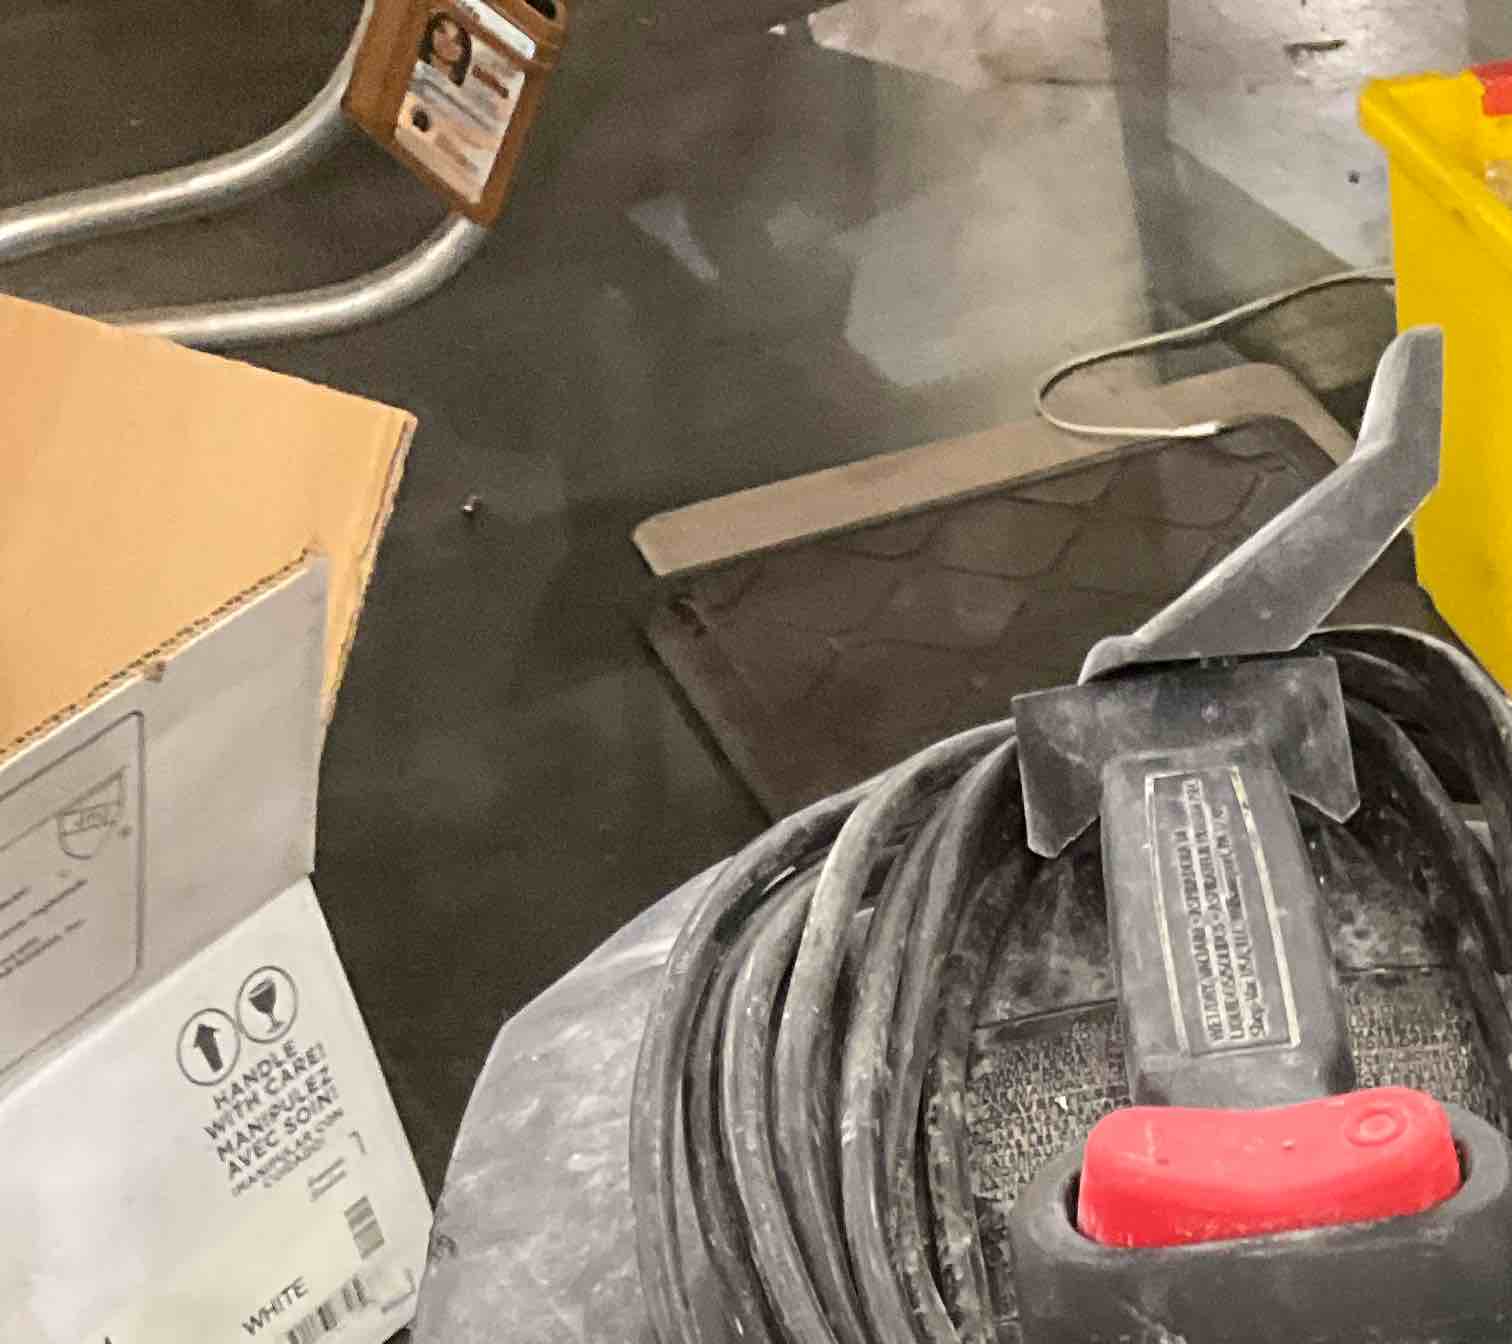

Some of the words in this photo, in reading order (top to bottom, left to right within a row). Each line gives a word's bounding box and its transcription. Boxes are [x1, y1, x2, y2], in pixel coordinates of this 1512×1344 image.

[213, 1040, 297, 1110] HANDLE
[204, 1091, 259, 1140] WITH
[228, 1130, 280, 1181] AVEC
[242, 1276, 309, 1337] WHITE
